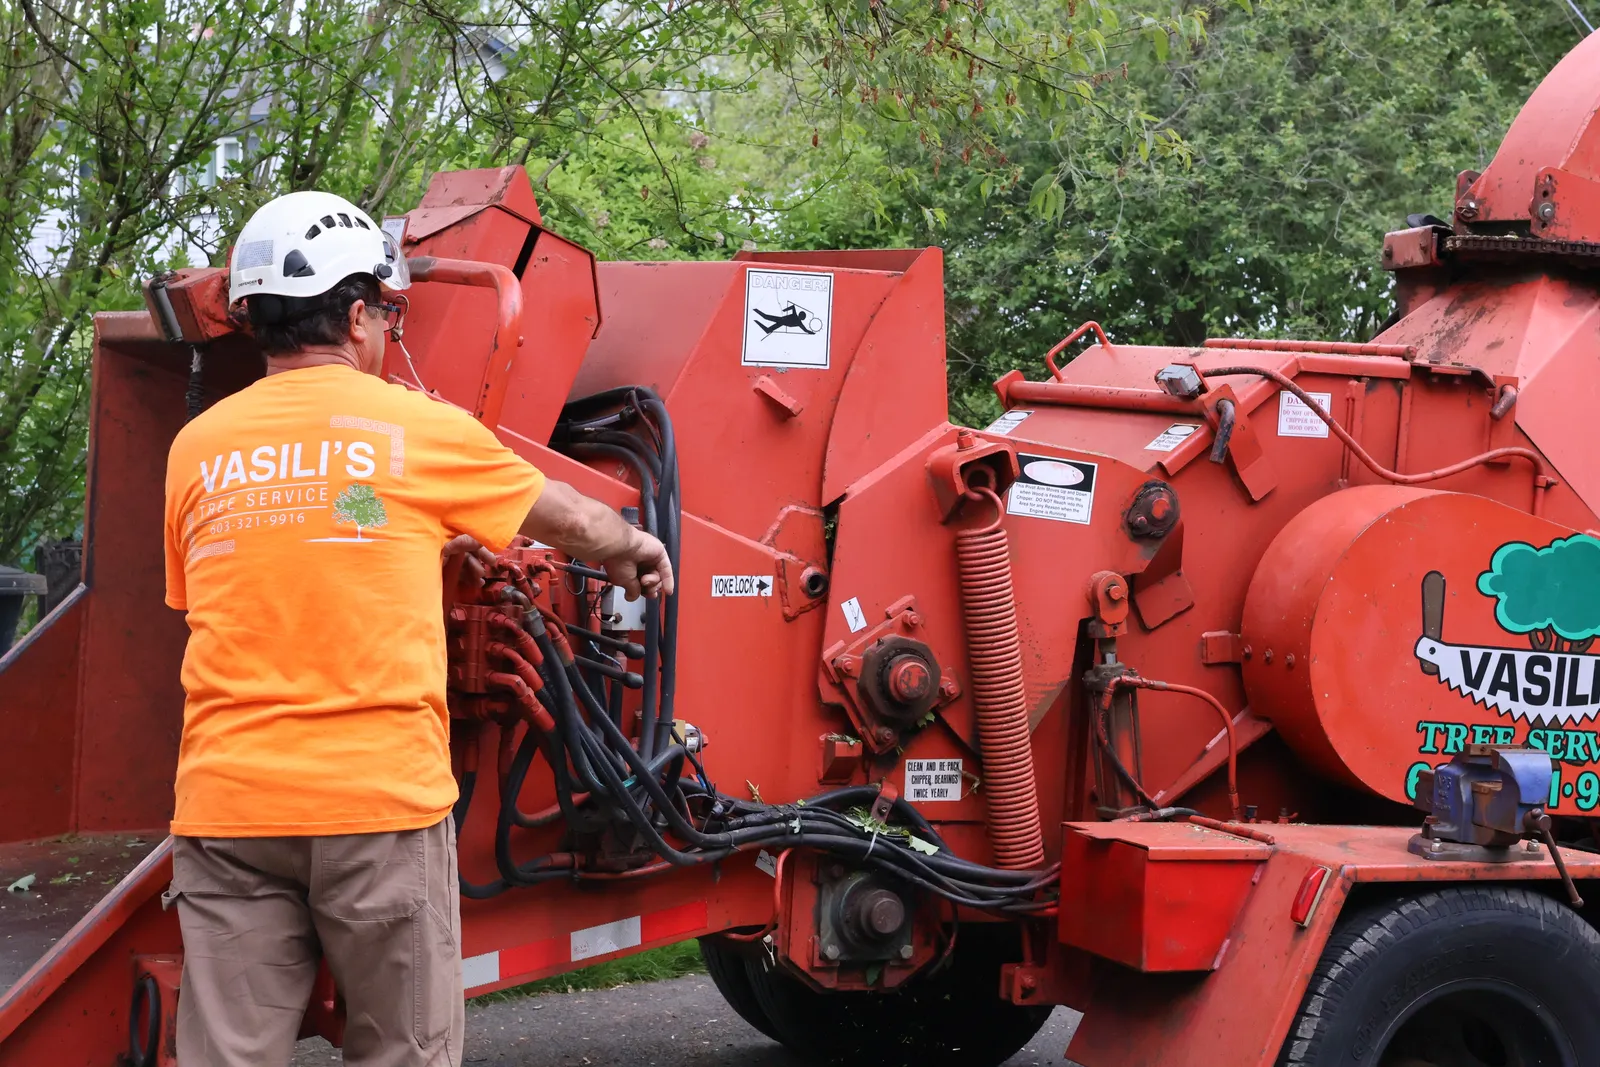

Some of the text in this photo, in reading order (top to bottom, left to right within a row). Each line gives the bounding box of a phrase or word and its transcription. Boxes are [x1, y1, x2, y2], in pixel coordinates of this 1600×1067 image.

[200, 441, 375, 493] VASILI'S
[199, 487, 328, 519] TREE SERVICE
[210, 512, 305, 535] 603-321-9916
[714, 578, 755, 594] YOKE LOCK
[907, 761, 923, 772] CLEAN
[926, 761, 936, 772] AND
[911, 774, 959, 785] CHIPPER BEARINGS
[913, 788, 949, 798] TWICE YEARLY
